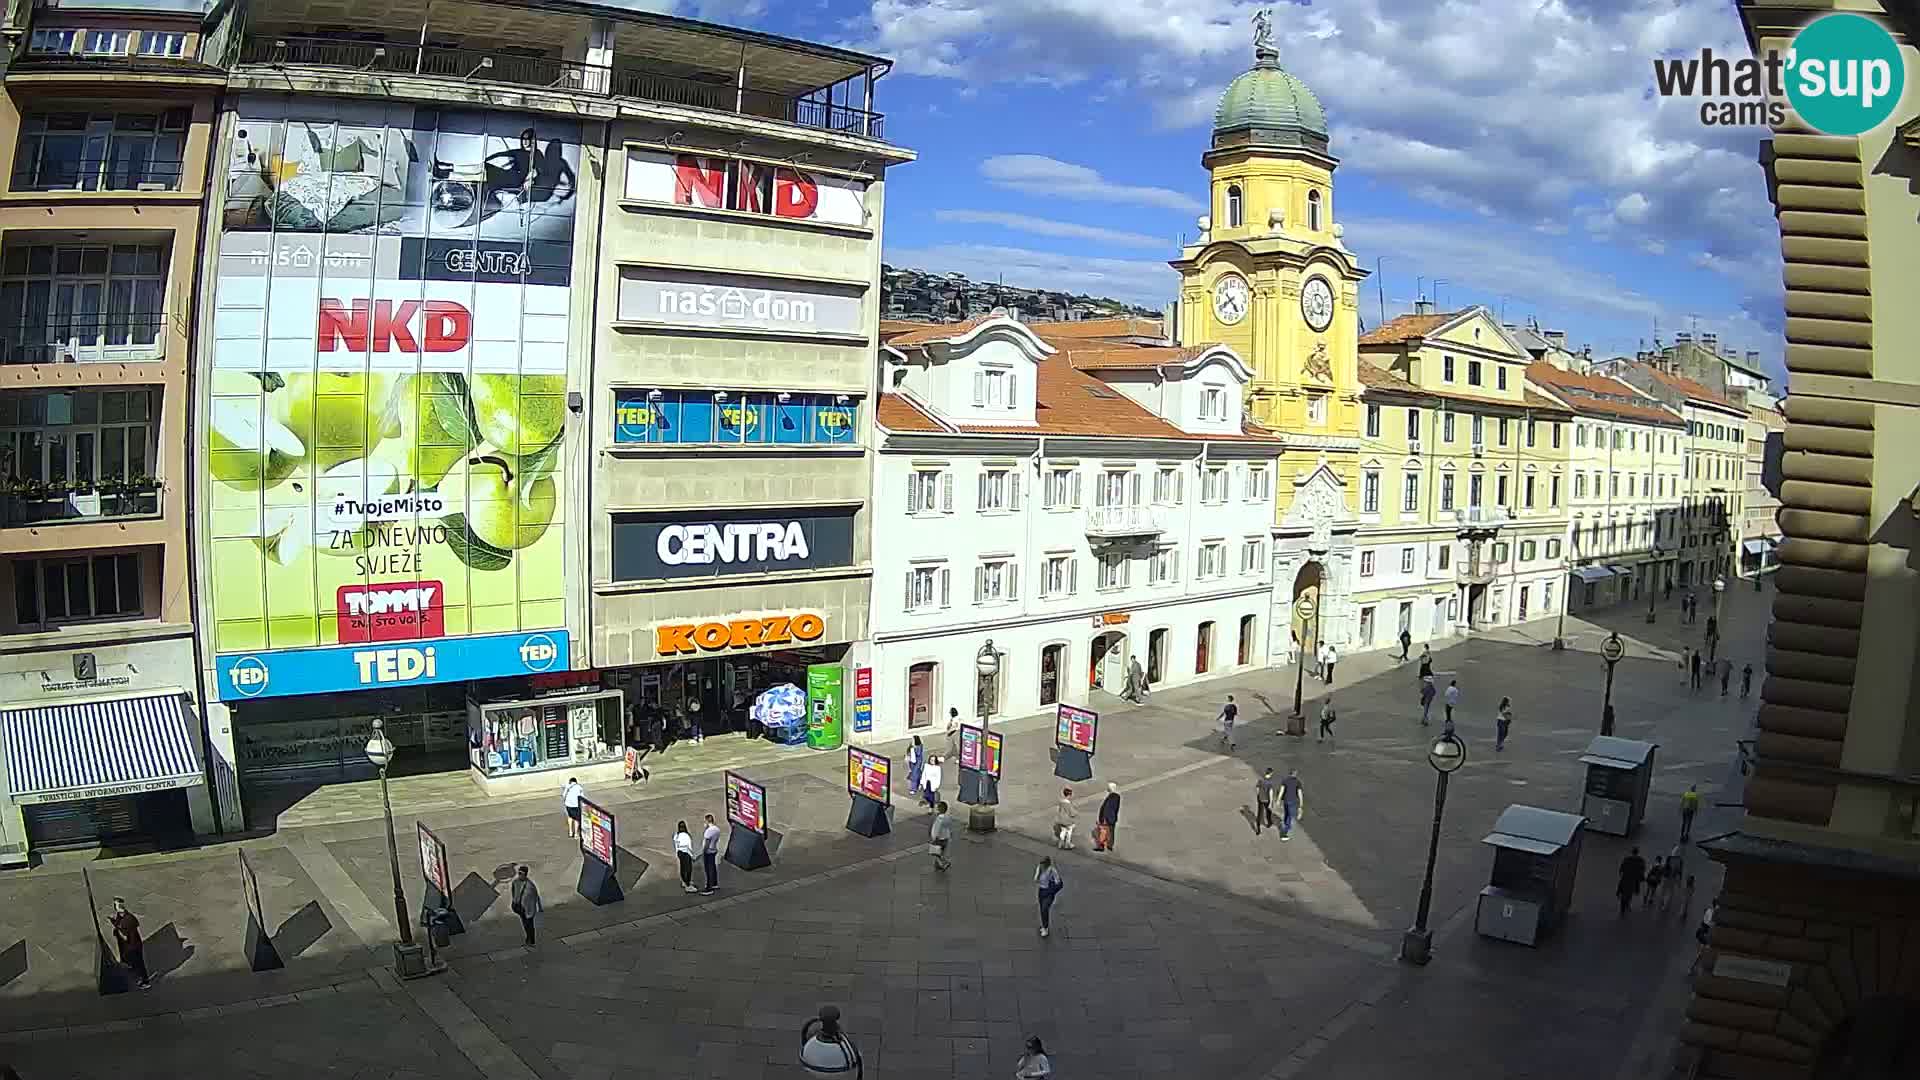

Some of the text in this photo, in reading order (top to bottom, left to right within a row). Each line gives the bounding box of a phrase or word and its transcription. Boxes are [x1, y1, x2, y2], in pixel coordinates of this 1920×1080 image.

[675, 156, 819, 219] NKD
[445, 248, 532, 275] CENTRA
[659, 286, 816, 322] naš dom
[318, 297, 473, 353] NKD
[334, 498, 443, 517] #TvojeMisto
[330, 524, 448, 549] ZA DNEVNO
[657, 521, 809, 565] CENTRA
[355, 548, 423, 576] SVJEŽE
[344, 587, 436, 616] TOMMY
[351, 619, 369, 629] ZN
[656, 613, 825, 656] KORZO
[354, 646, 437, 684] TEDi
[519, 640, 557, 662] TEDi
[229, 666, 269, 686] TEDi
